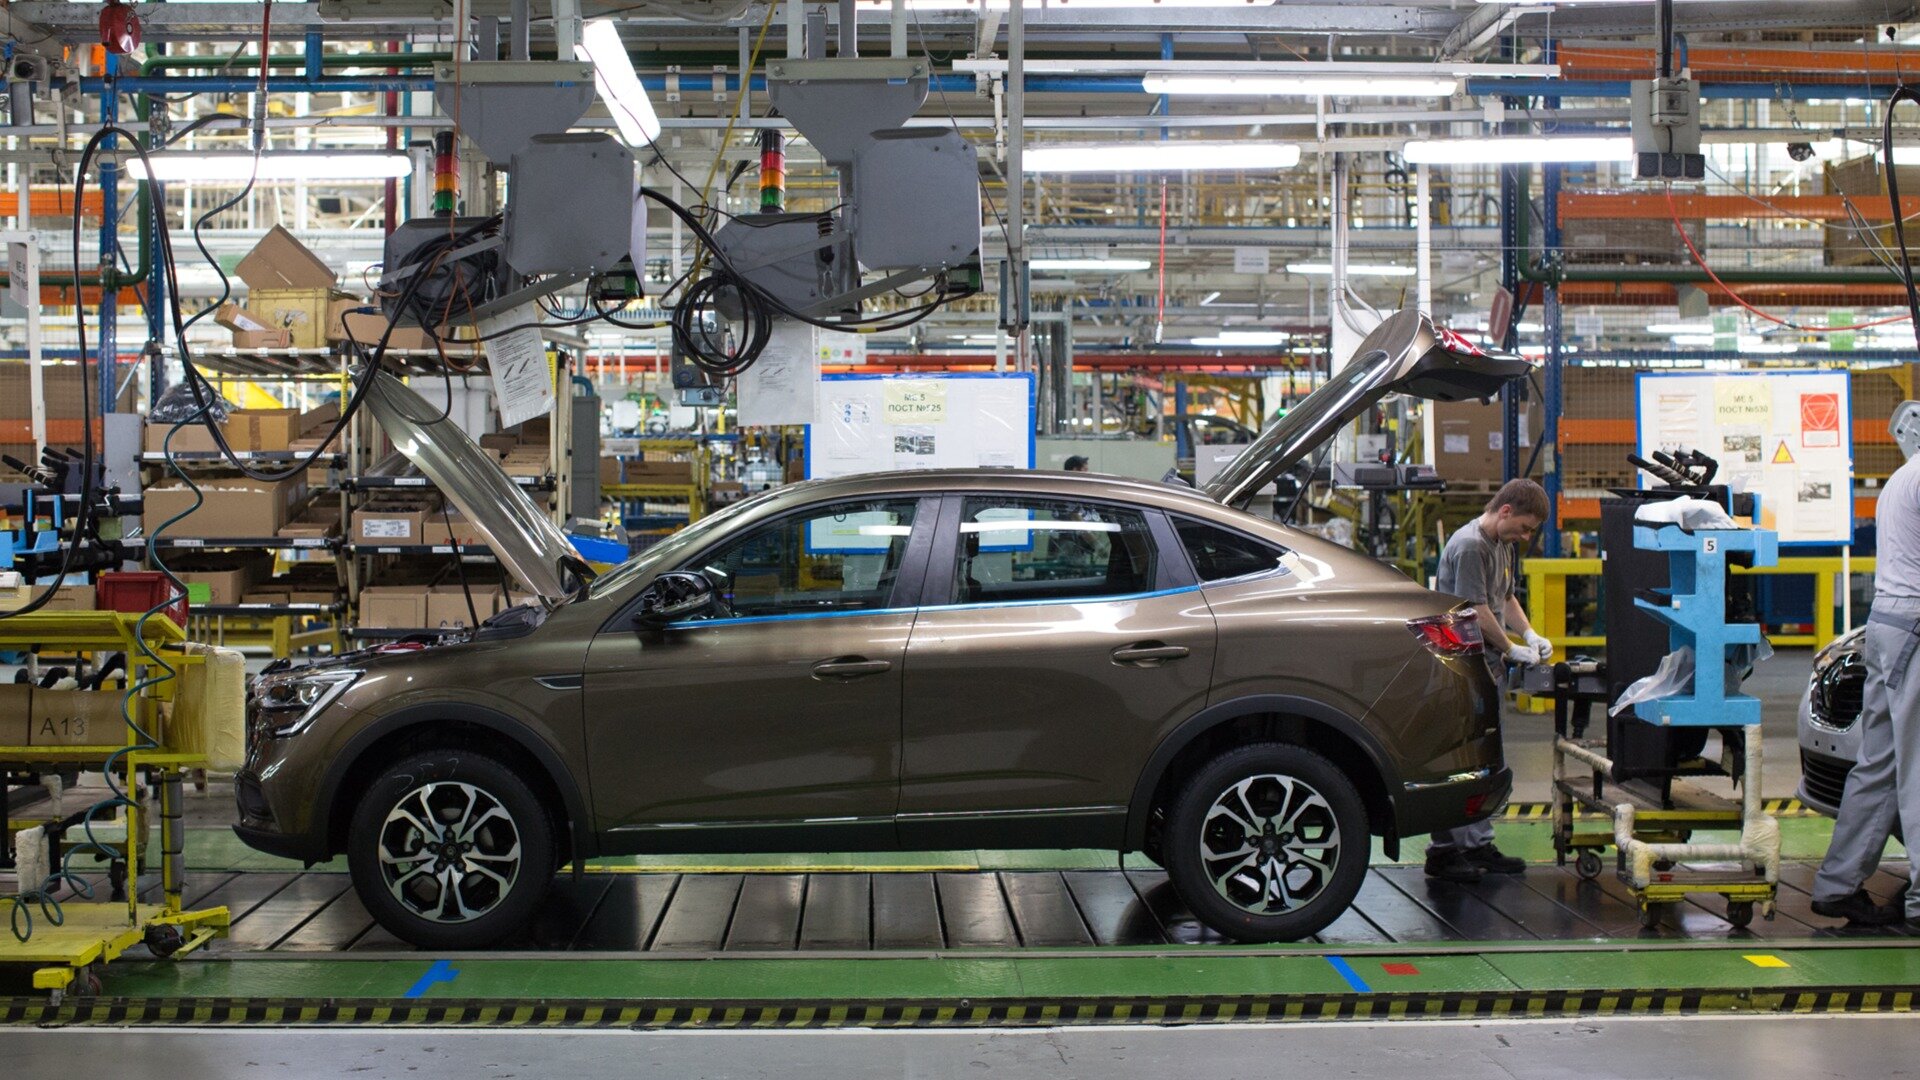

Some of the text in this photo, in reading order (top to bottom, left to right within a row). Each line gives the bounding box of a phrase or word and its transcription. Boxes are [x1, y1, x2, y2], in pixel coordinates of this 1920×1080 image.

[920, 393, 926, 401] 5
[888, 404, 913, 412] ПОСТ
[1707, 540, 1714, 551] 5
